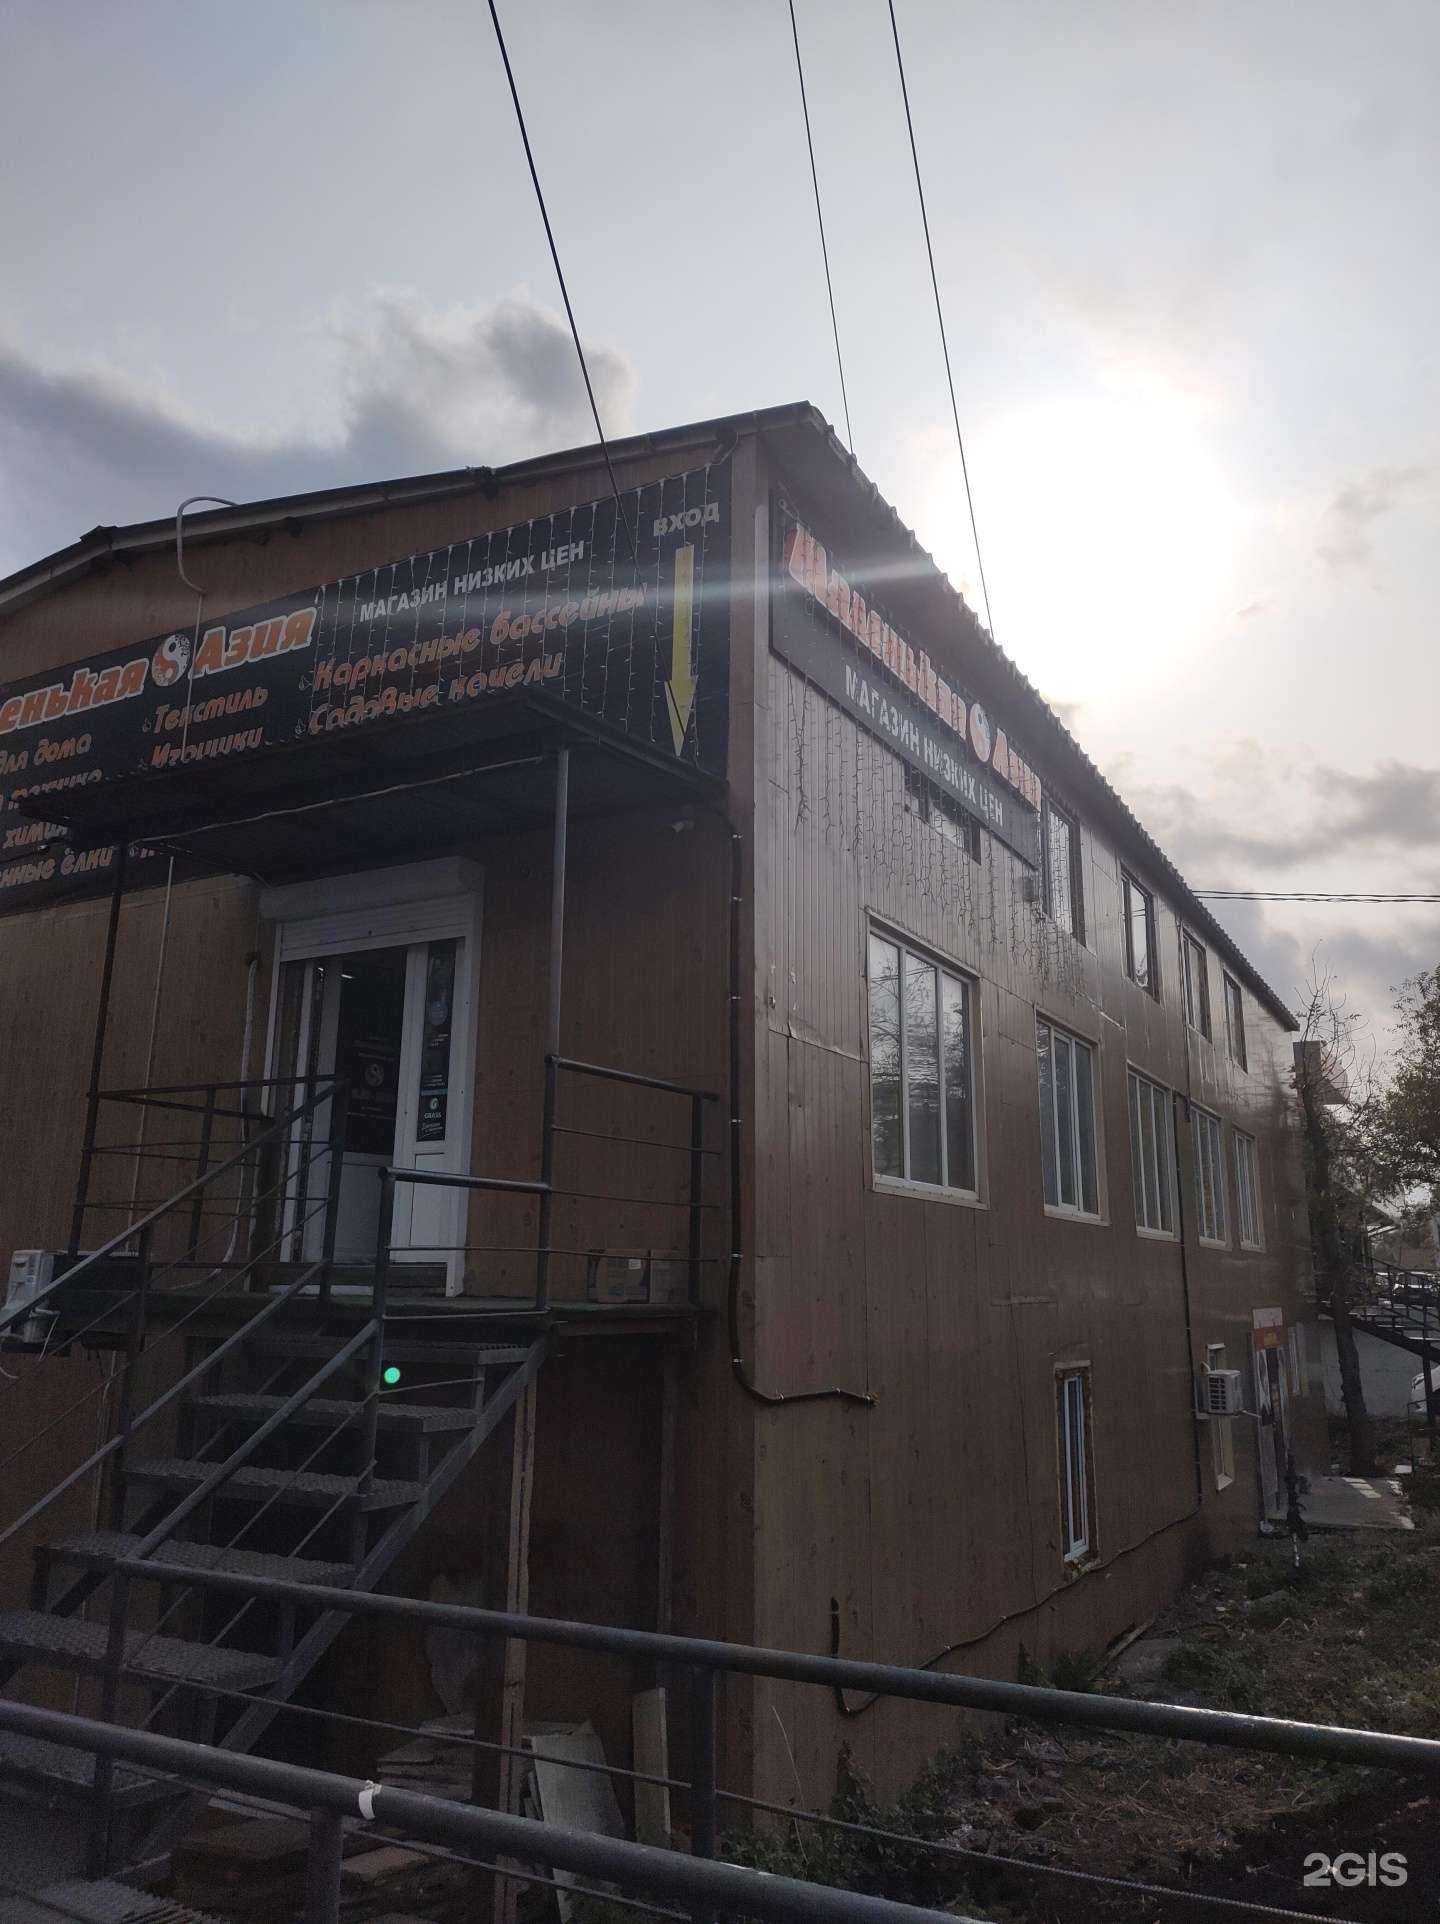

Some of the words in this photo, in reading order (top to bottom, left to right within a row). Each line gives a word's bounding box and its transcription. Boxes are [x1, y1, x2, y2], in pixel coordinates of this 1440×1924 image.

[653, 500, 720, 537] ВХОД
[360, 579, 448, 622] МАГАЗИН
[454, 555, 535, 594] НИЗКИХ
[541, 540, 585, 571] ЦЕН
[190, 607, 317, 679] Азия
[154, 686, 269, 733] Текстиль
